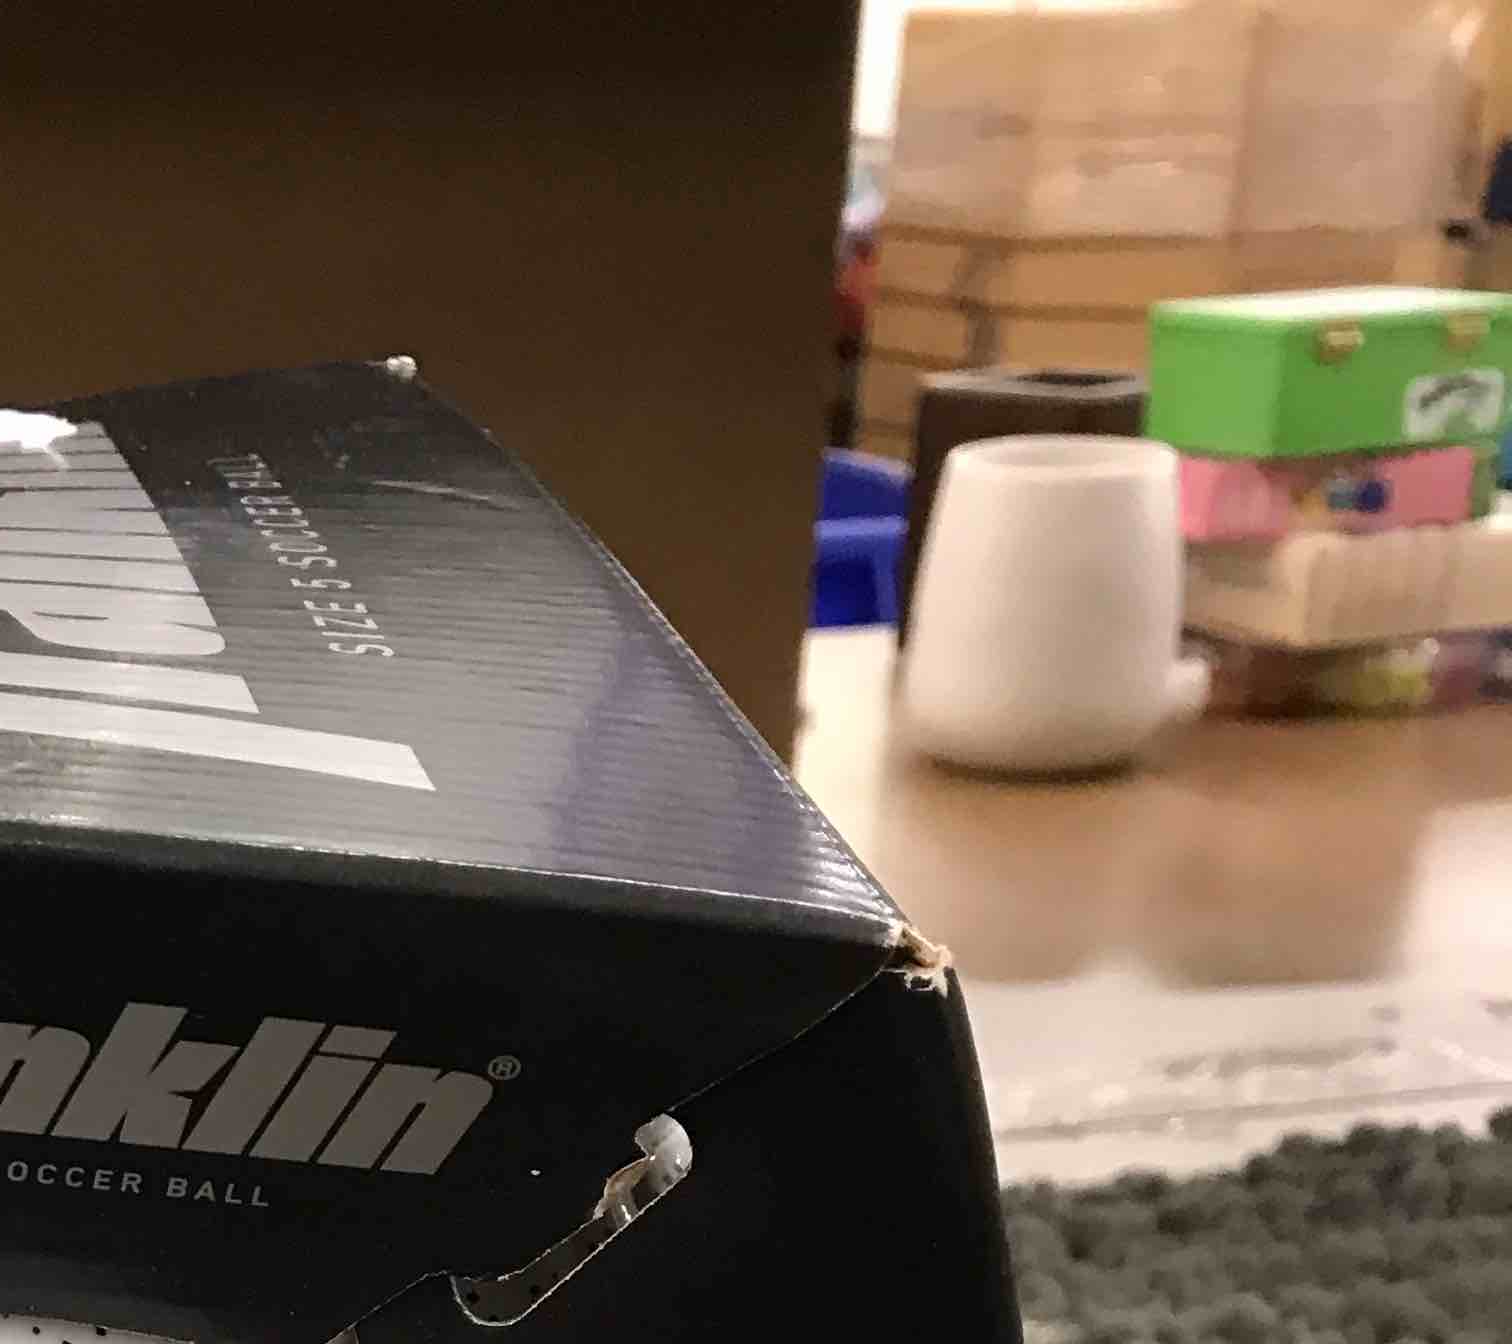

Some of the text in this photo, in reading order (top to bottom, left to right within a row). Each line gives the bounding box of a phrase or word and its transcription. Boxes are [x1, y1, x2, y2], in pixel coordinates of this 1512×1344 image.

[205, 452, 395, 657] SIZE 5 SOCCER BALL
[165, 1176, 271, 1208] BALL
